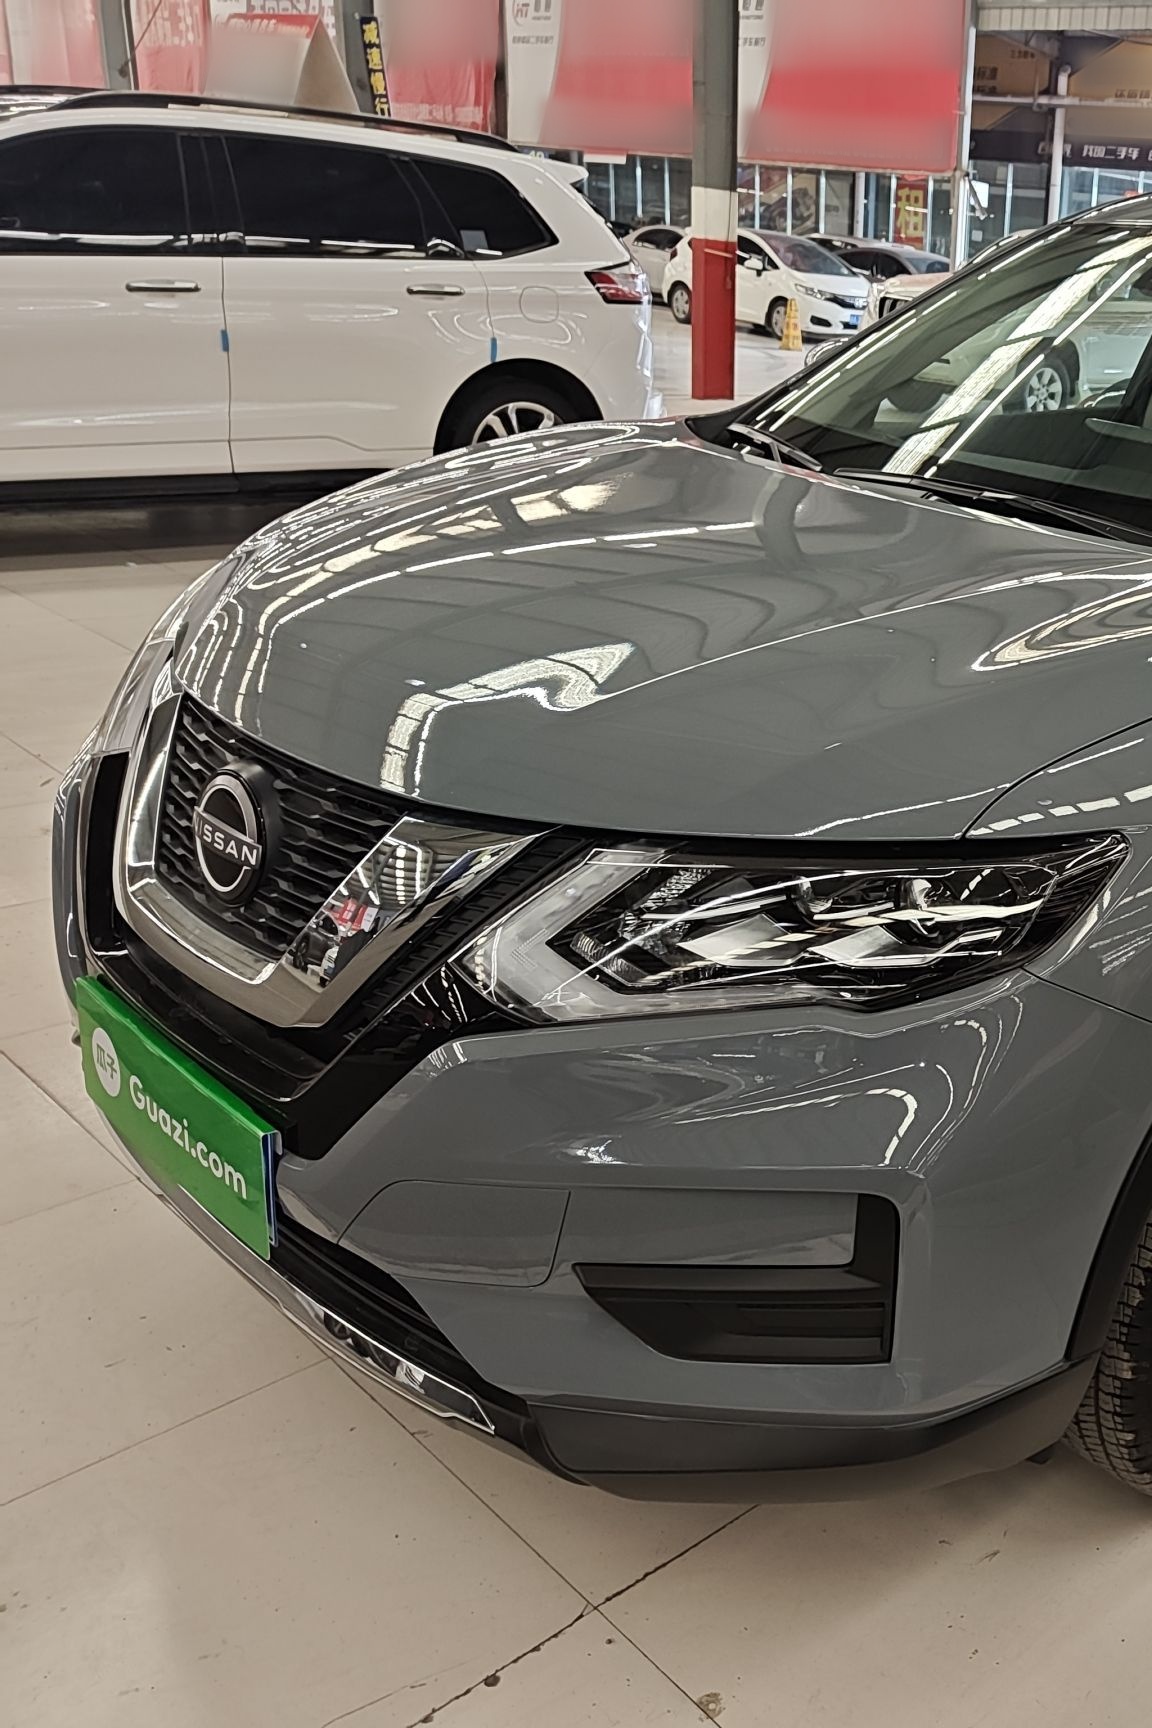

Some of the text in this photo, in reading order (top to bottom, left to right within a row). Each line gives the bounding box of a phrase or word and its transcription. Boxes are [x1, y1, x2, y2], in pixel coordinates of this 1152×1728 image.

[897, 187, 924, 238] 租
[96, 1043, 118, 1080] 瓜子
[129, 1074, 247, 1200] Guazi.com
